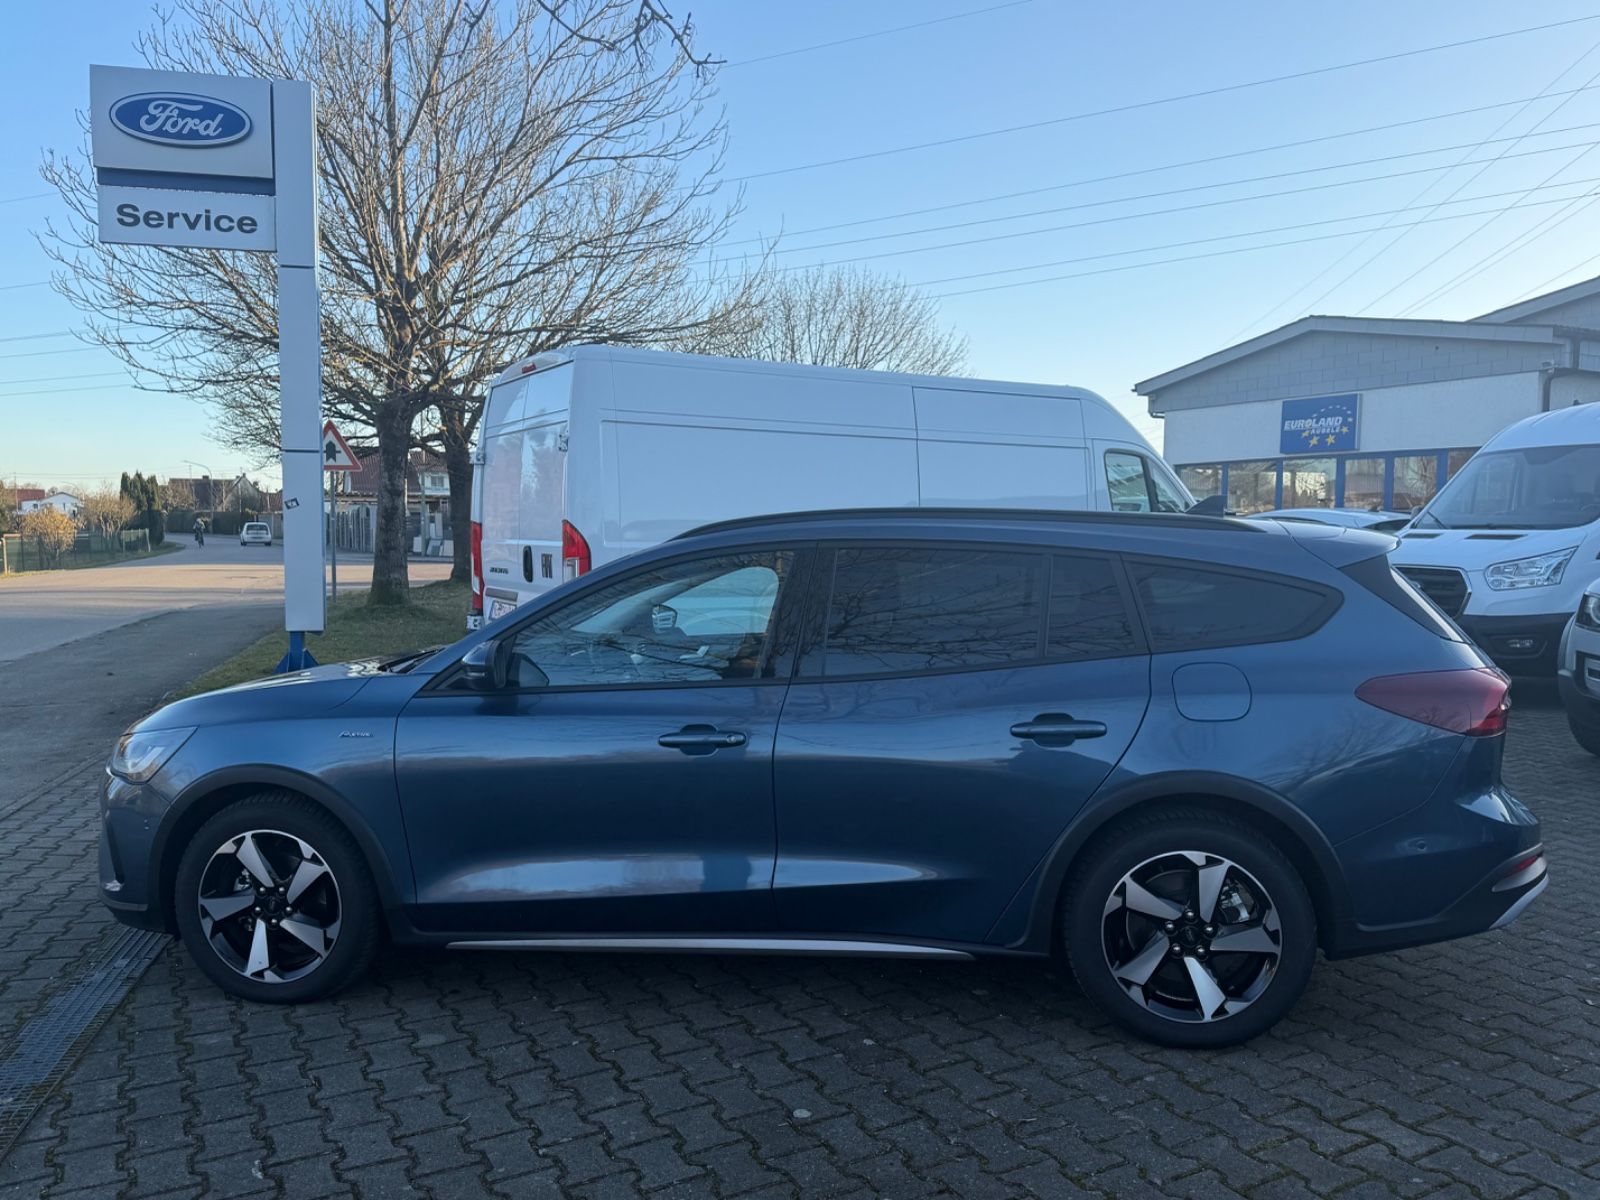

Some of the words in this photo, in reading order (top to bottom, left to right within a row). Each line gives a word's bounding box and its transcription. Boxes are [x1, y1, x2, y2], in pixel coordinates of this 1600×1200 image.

[139, 99, 223, 138] Ford
[115, 203, 259, 235] Service
[1283, 415, 1343, 432] EUROLAND
